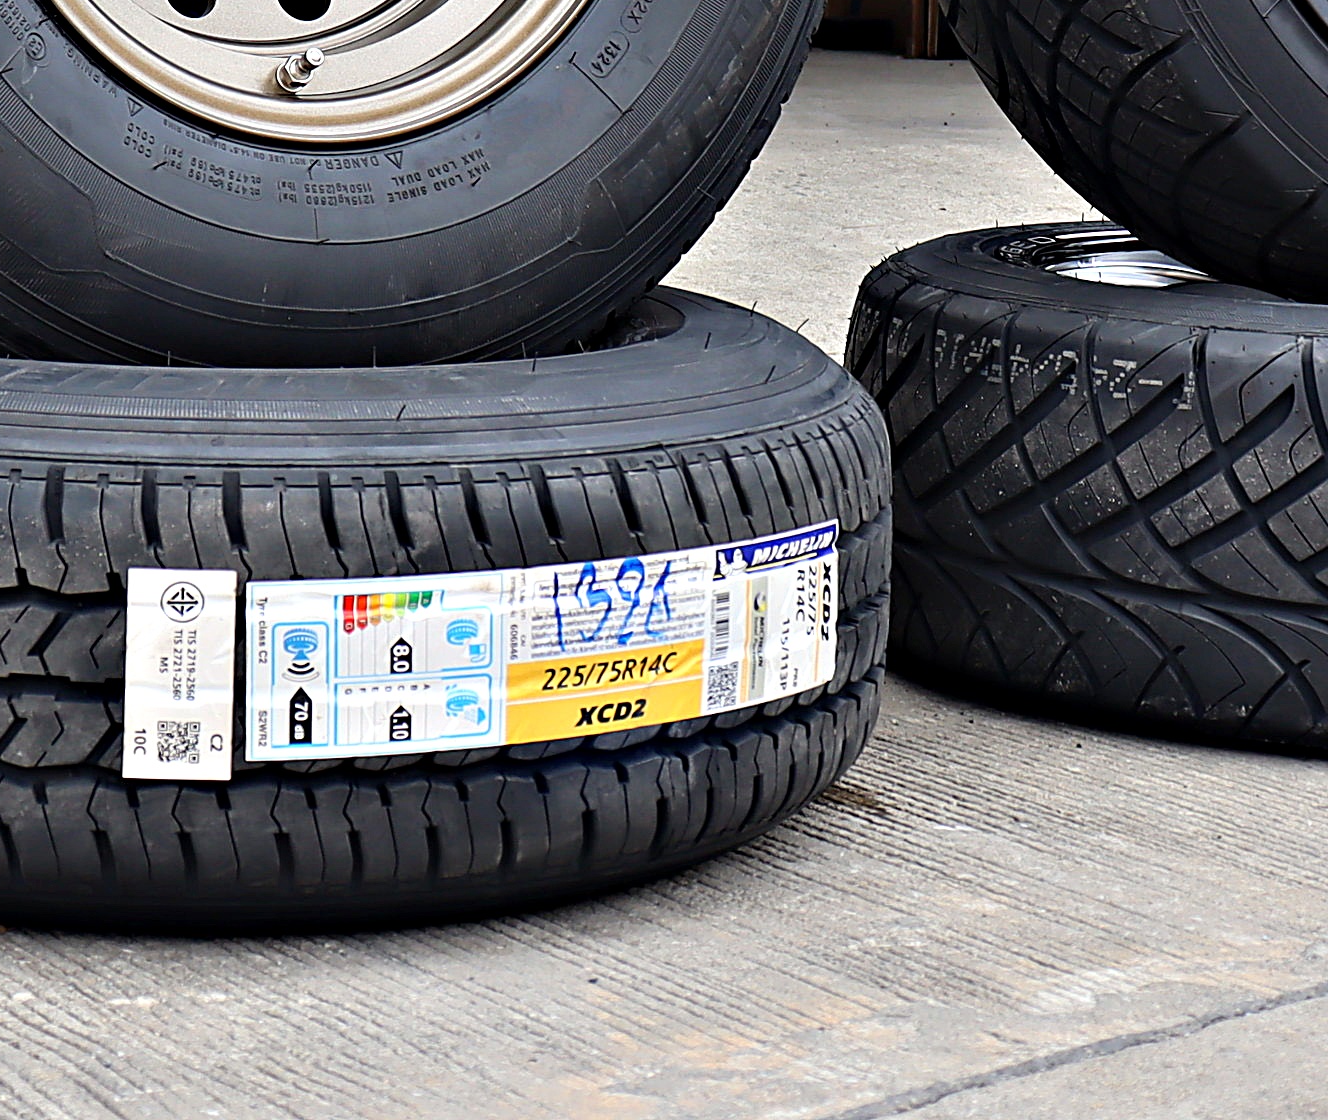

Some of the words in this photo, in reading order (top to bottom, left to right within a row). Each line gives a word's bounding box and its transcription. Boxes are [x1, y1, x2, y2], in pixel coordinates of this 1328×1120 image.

[590, 38, 626, 81] 1324
[123, 122, 156, 149] COLD
[119, 135, 153, 163] COLD
[323, 153, 380, 176] DANGER
[424, 159, 459, 183] LOAD
[390, 171, 423, 192] DUAL
[432, 173, 465, 196] LOAD
[386, 184, 429, 208] SINGLE
[751, 531, 835, 567] MICHELIN
[795, 569, 806, 622] R14C
[806, 565, 818, 636] 225/75
[820, 562, 832, 642] XCD2
[173, 630, 183, 645] TIS
[187, 630, 197, 645] TIS
[159, 657, 169, 674] MS
[258, 652, 268, 664] C2
[392, 644, 410, 673] 8.0
[778, 618, 791, 691] 115/113P
[542, 652, 678, 691] 225/75R14C
[294, 702, 309, 721] 70
[575, 698, 647, 727] XCD2
[392, 710, 410, 740] 1.10
[133, 729, 147, 755] 10C
[210, 734, 224, 752] C2
